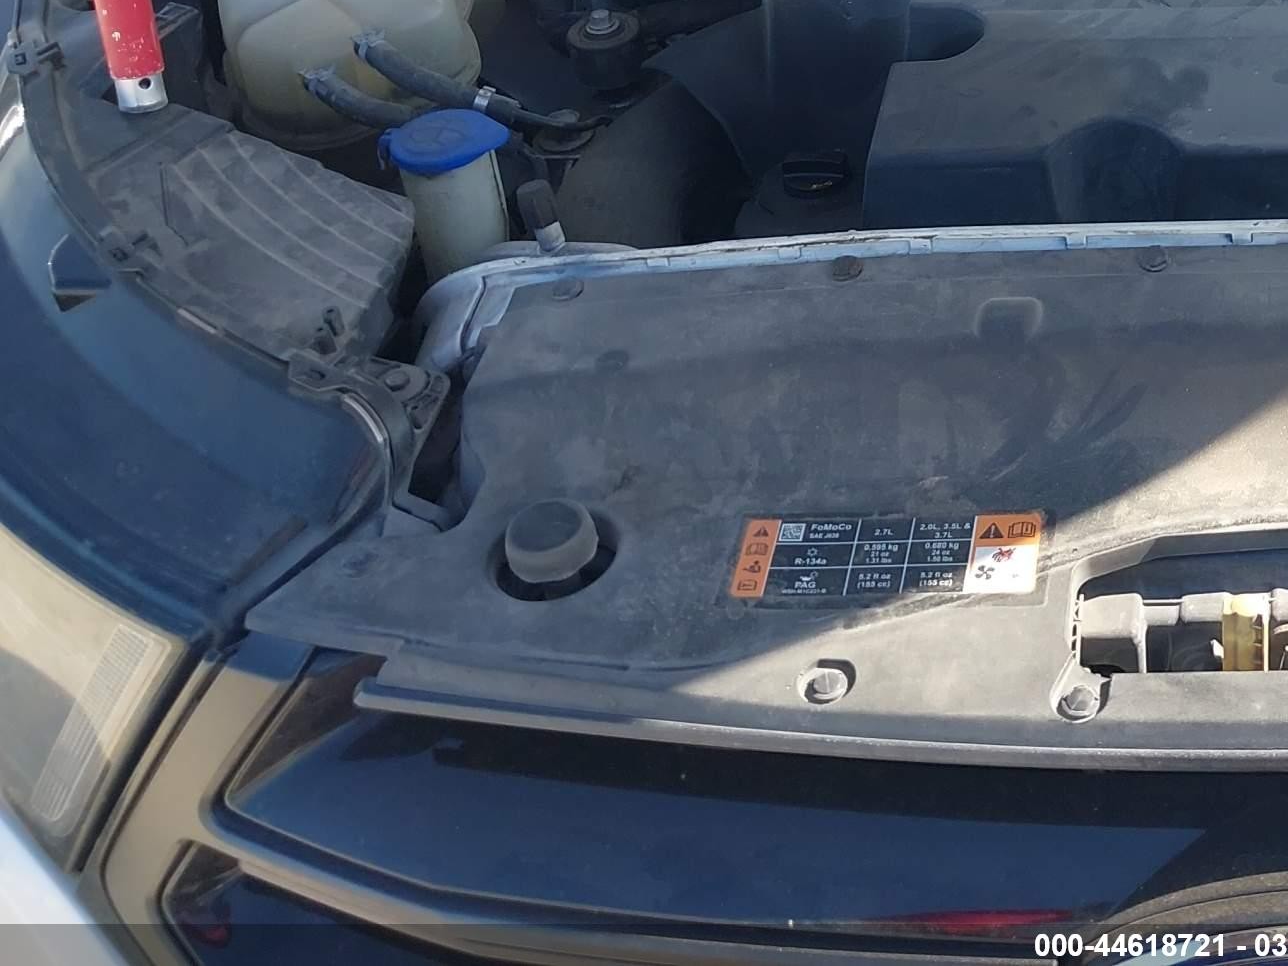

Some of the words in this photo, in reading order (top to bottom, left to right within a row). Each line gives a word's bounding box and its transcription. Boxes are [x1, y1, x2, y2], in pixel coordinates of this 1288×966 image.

[811, 523, 852, 531] FoMoCo
[887, 543, 899, 552] kg
[948, 542, 960, 551] kg
[794, 557, 827, 565] R-134a
[794, 581, 816, 589] PAG
